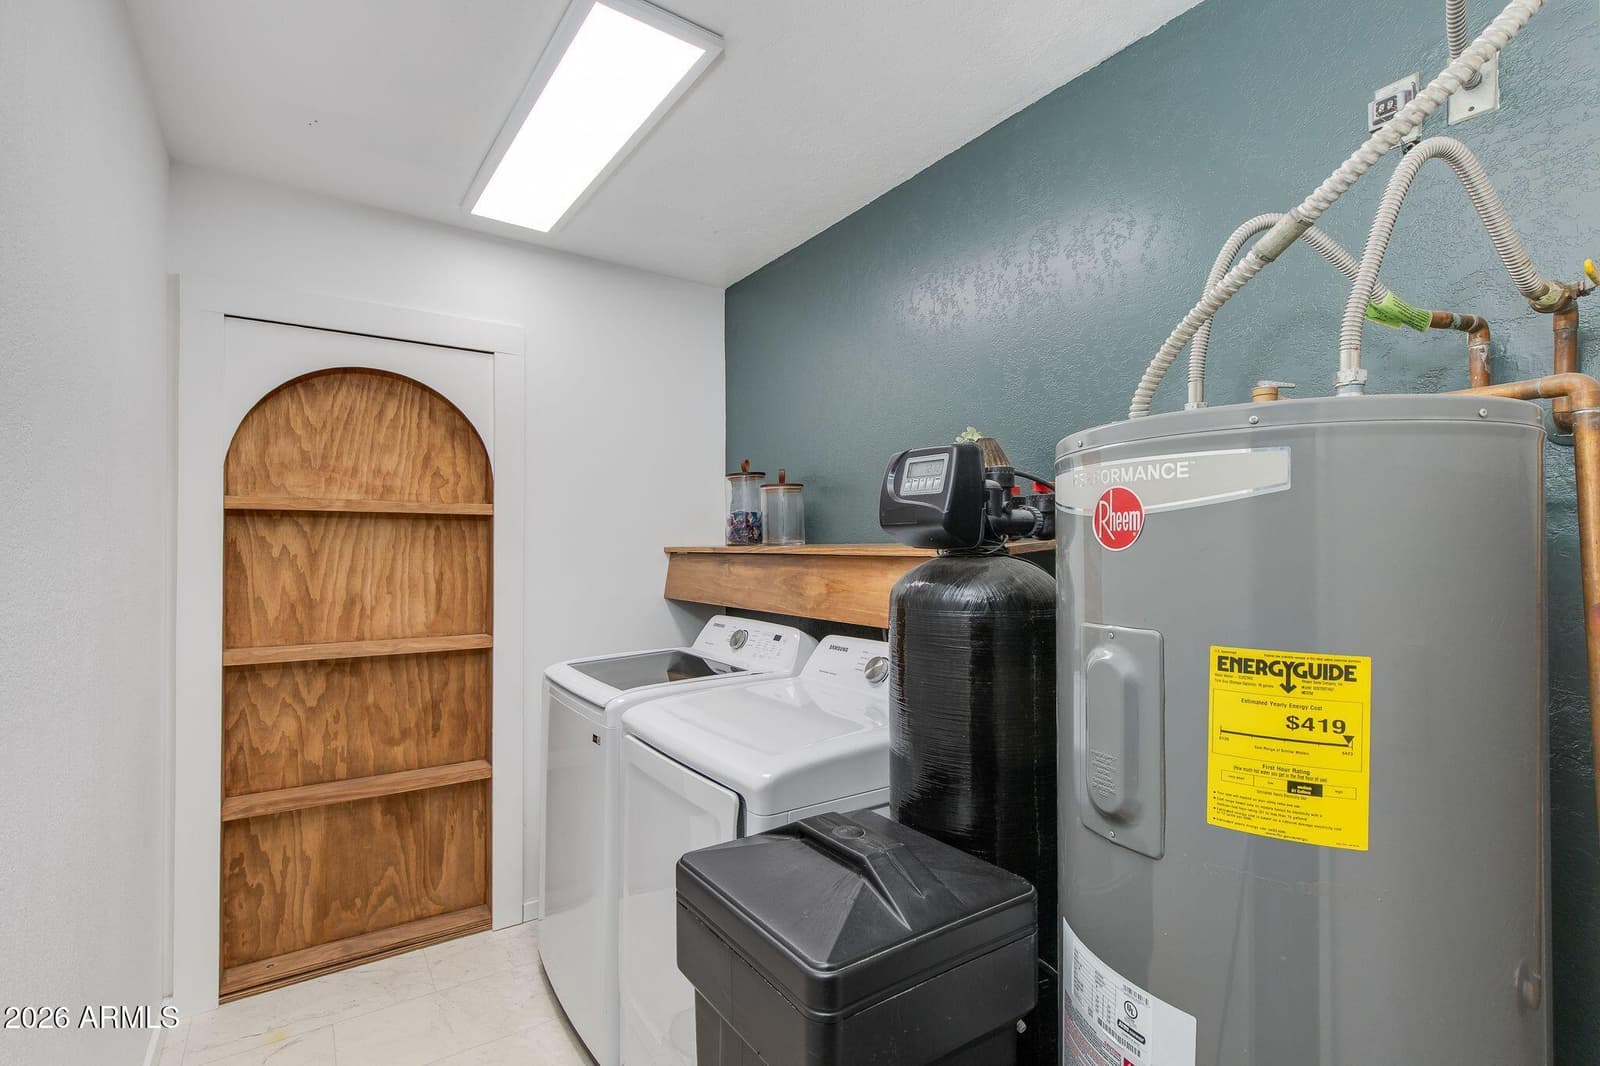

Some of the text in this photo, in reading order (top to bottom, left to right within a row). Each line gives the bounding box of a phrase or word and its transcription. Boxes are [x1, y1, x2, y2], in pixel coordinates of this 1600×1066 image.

[1074, 462, 1190, 487] PEORMANCE
[1098, 489, 1142, 540] Rheem
[829, 644, 849, 653] SAMSUNG
[1217, 655, 1357, 690] ENERGYGUIDE
[1241, 698, 1268, 706] Estimated
[1269, 700, 1287, 709] Yearly
[1288, 702, 1309, 711] Energy
[1286, 715, 1346, 735] $419
[1292, 767, 1311, 775] Rating
